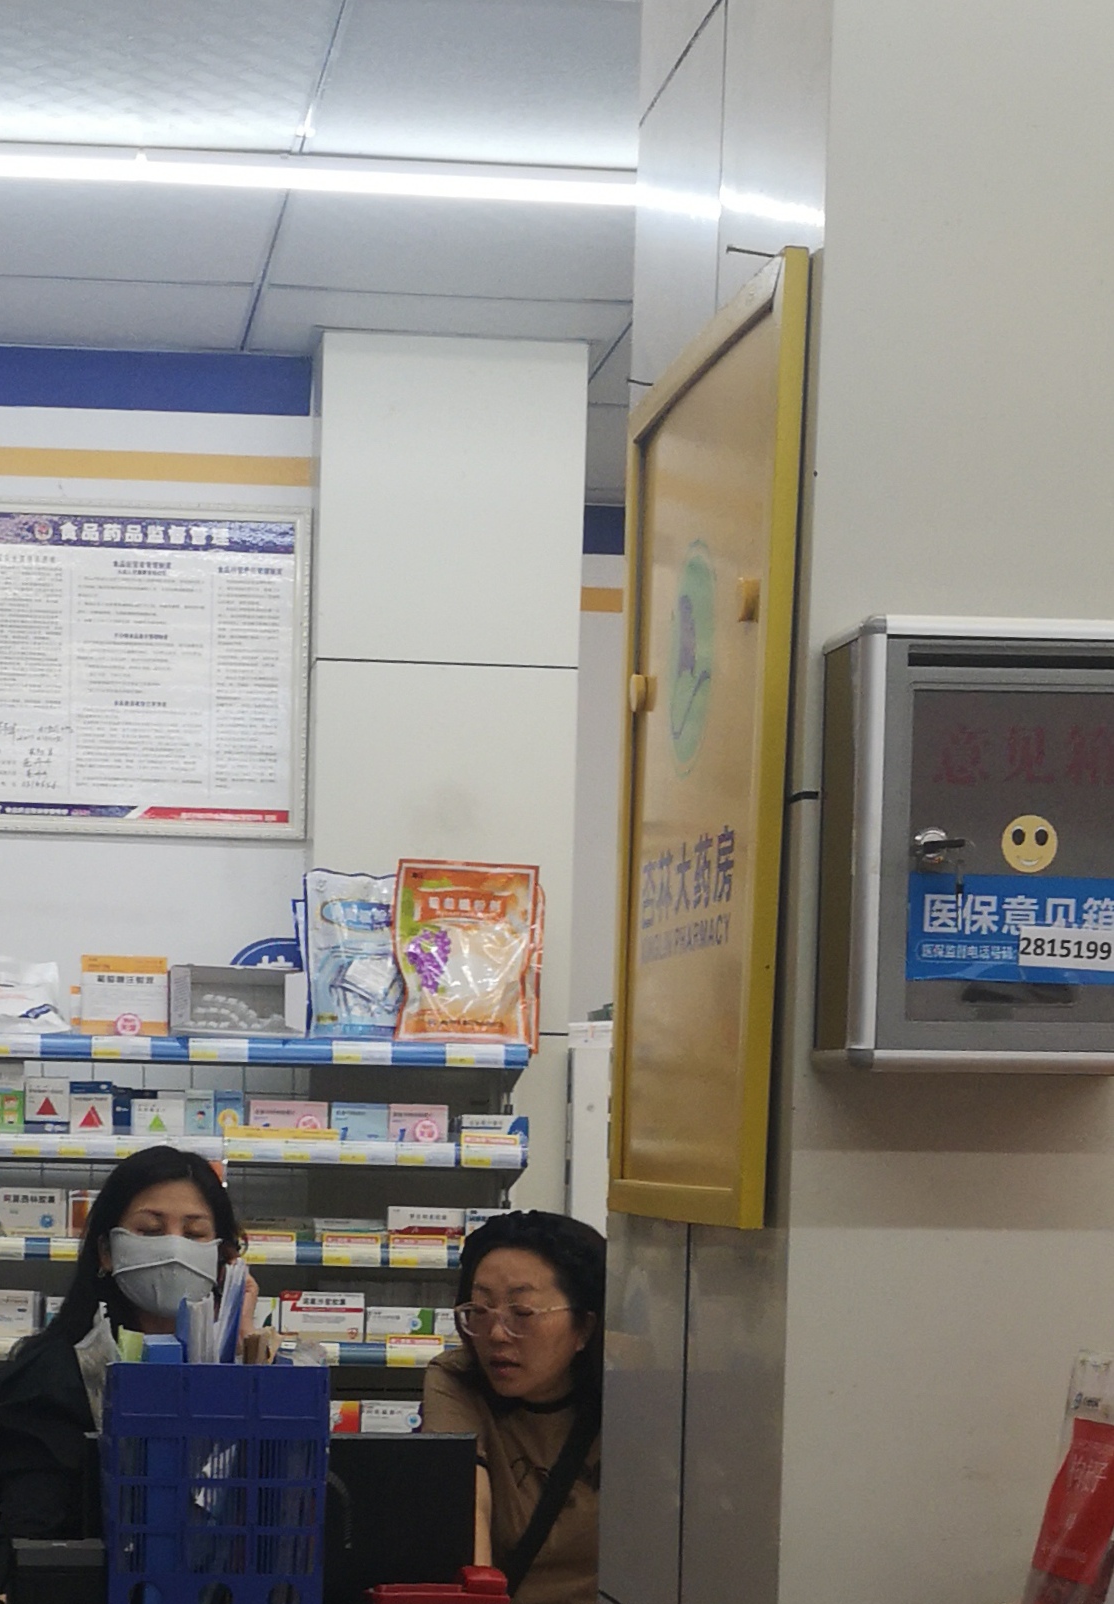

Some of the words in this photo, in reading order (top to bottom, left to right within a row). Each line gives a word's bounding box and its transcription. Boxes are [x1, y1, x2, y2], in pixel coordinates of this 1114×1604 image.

[60, 521, 230, 546] 食品药品监督管理
[923, 893, 1114, 937] 医保意见箱
[1019, 936, 1112, 961] 2815199
